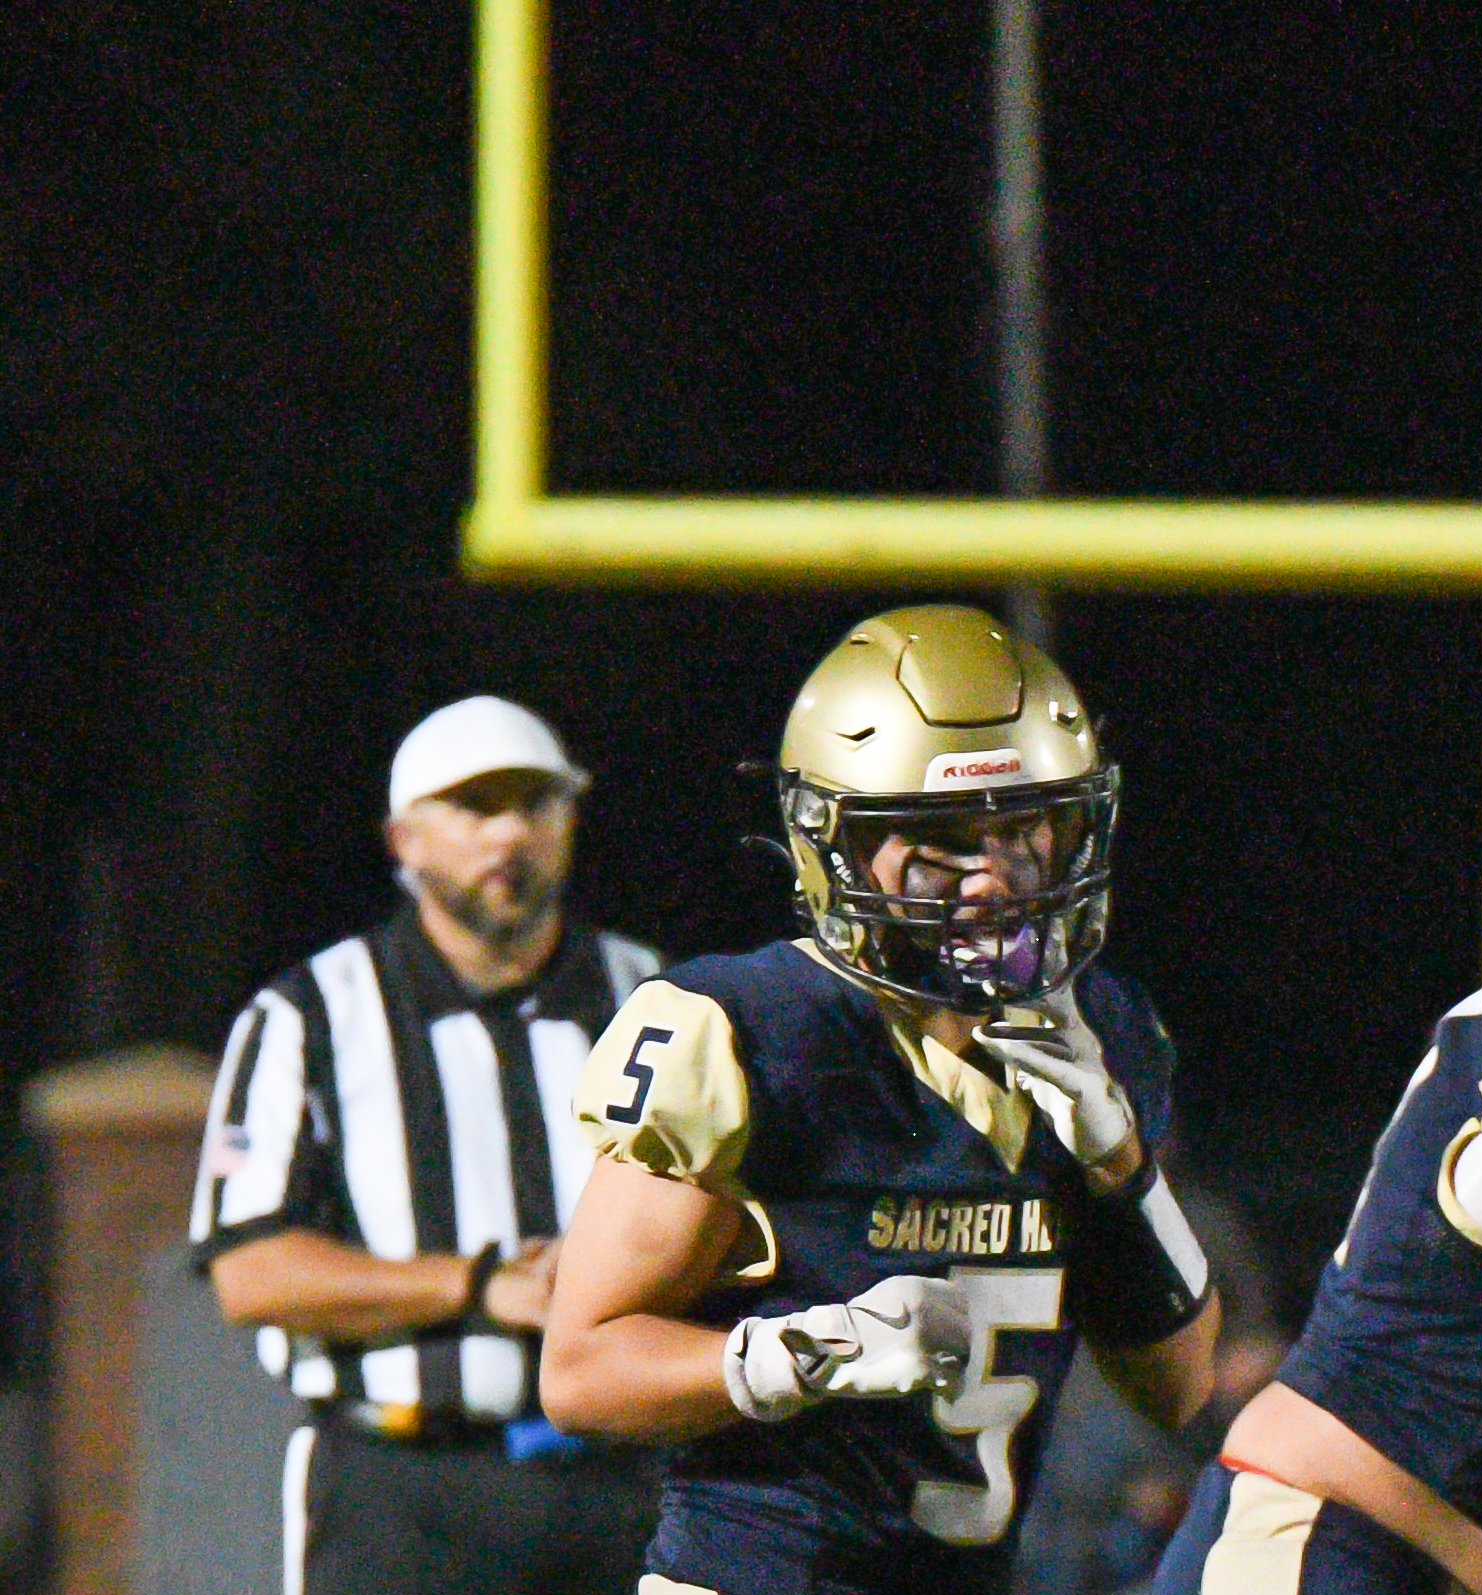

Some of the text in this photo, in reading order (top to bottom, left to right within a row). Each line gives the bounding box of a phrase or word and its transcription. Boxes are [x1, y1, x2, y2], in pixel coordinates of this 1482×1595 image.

[604, 1023, 677, 1127] 5
[868, 1200, 1012, 1255] SACRED
[909, 1265, 1066, 1546] 5
